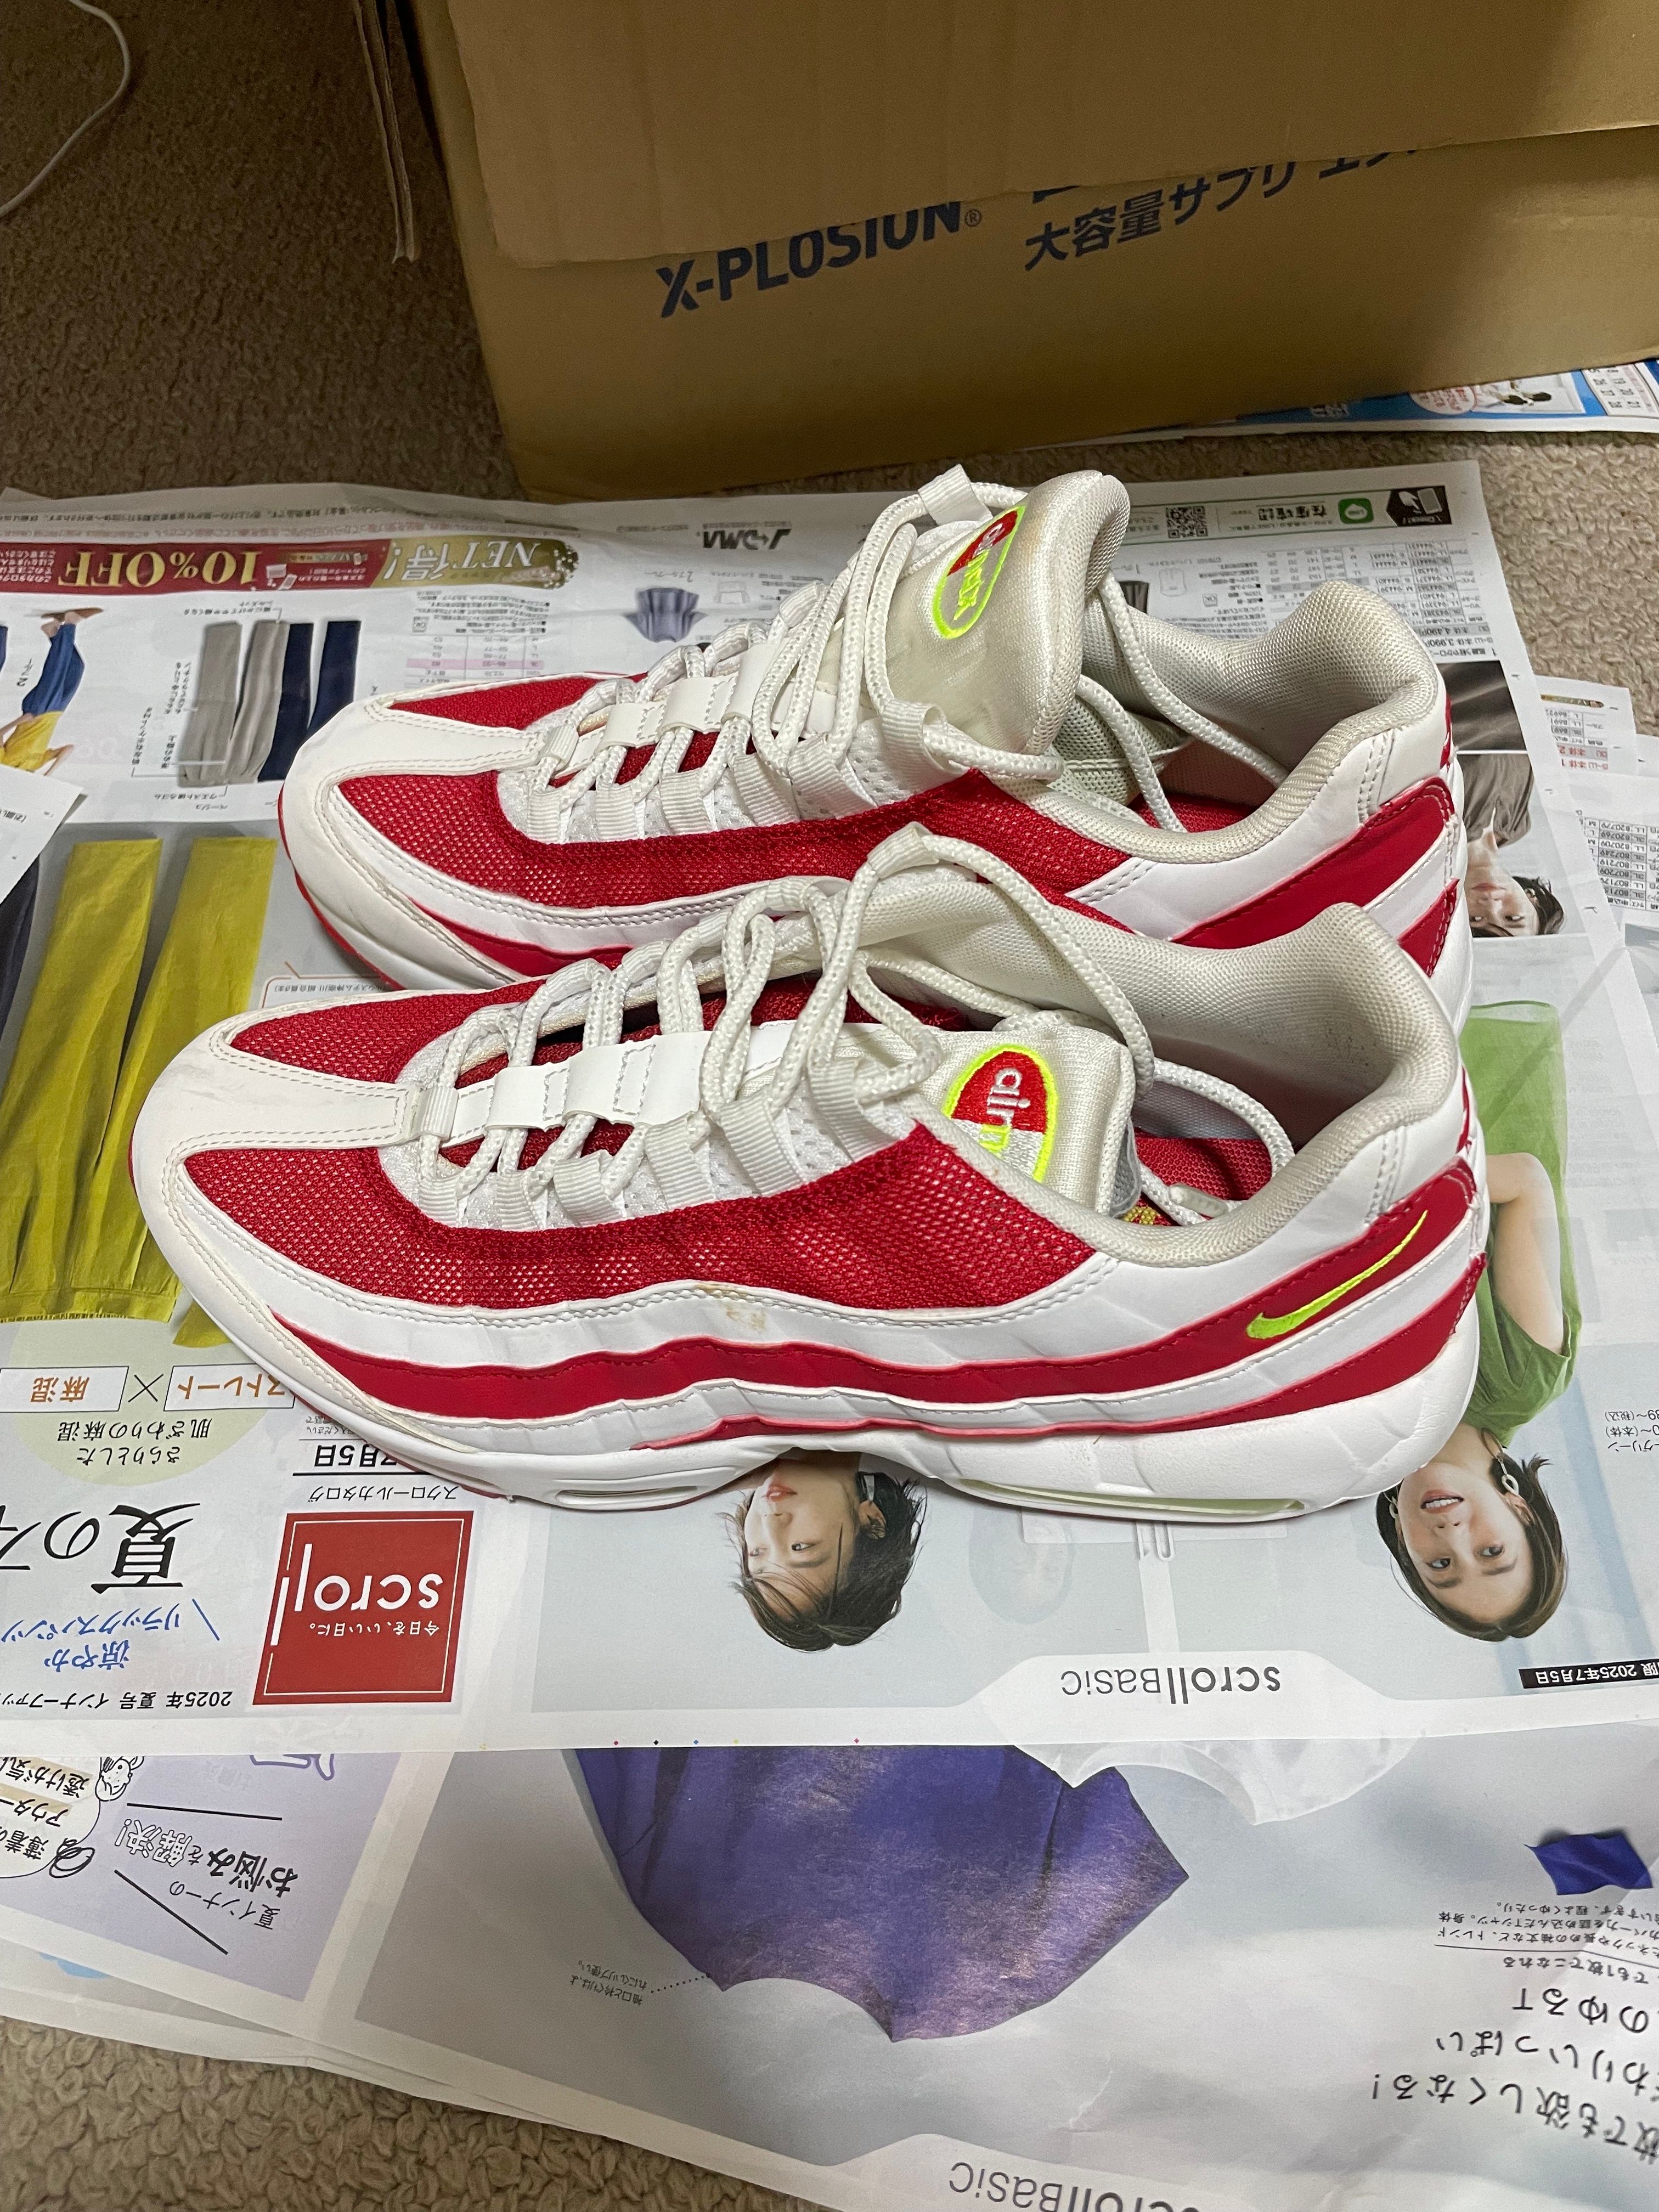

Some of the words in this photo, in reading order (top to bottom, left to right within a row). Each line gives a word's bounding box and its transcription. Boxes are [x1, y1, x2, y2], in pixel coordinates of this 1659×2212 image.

[30, 1376, 89, 1403] 麻混
[177, 1373, 286, 1400] ストレート
[57, 1419, 212, 1442] 肌ざわりの麻混
[76, 1446, 180, 1466] さらりとした
[270, 1543, 443, 1646] scroll
[1, 1603, 180, 1643] リラックスパンツ
[309, 1621, 439, 1637] 今日を、いい日に。
[44, 1640, 130, 1673] 涼やか
[1640, 1662, 1659, 1677] 限
[1535, 1664, 1637, 1684] 2025年7月5日
[0, 1692, 109, 1709] インナーファッ
[119, 1691, 157, 1709] 夏号
[166, 1691, 233, 1709] 2025年
[115, 1819, 298, 1898] お悩みを解決!
[170, 1881, 280, 1930] 夏インナーの
[579, 1961, 646, 1990] れにくいリブ使い。
[1503, 1956, 1649, 1985] でも1枚でこなれる
[570, 1975, 642, 2006] 袖口と衿ぐりは、よ
[1511, 1988, 1649, 2034] のゆるT
[1436, 2031, 1659, 2102] わりいっぱい
